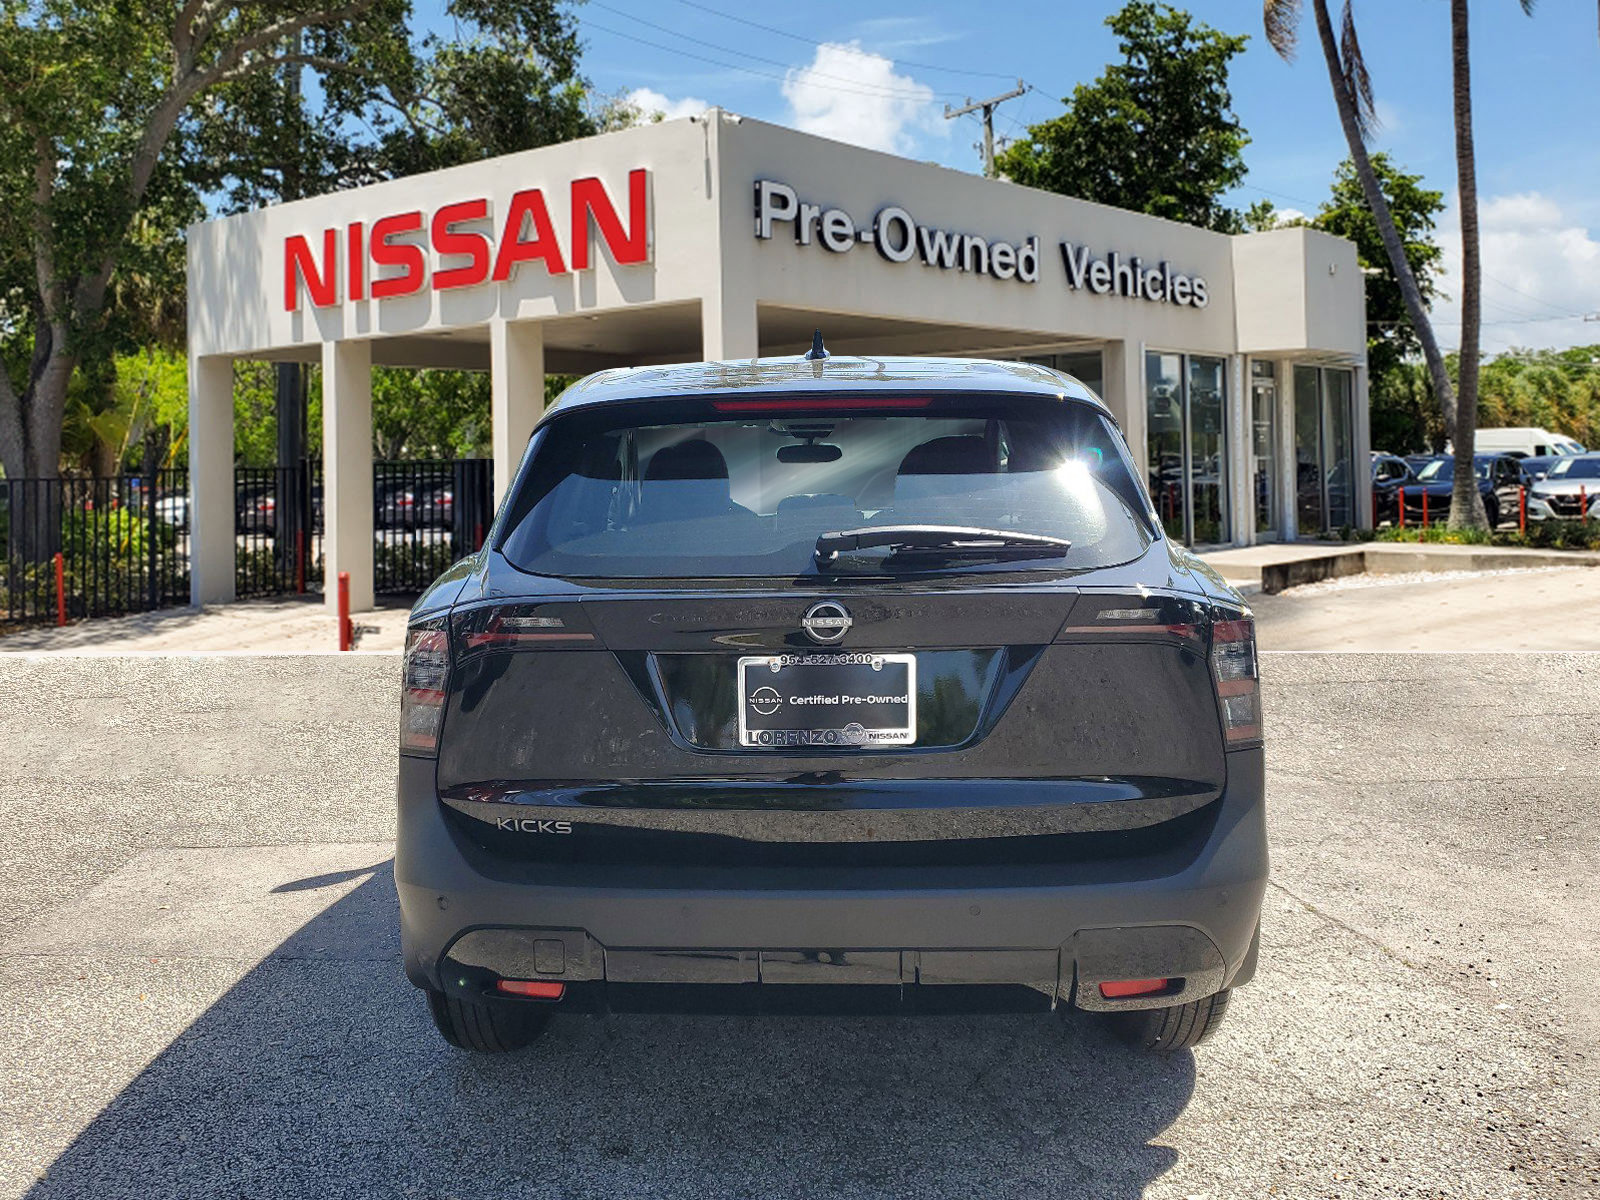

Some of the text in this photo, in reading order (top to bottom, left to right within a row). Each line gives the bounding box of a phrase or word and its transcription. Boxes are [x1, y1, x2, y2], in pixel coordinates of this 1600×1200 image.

[285, 169, 648, 312] NISSAN
[754, 179, 1209, 309] Pre-Owned Vehicles
[780, 654, 873, 665] 954-527-3400
[789, 693, 909, 706] Certified Pre-Owned
[747, 730, 838, 744] LORENZO
[868, 731, 909, 741] NISSAN
[496, 817, 572, 834] KICKS
